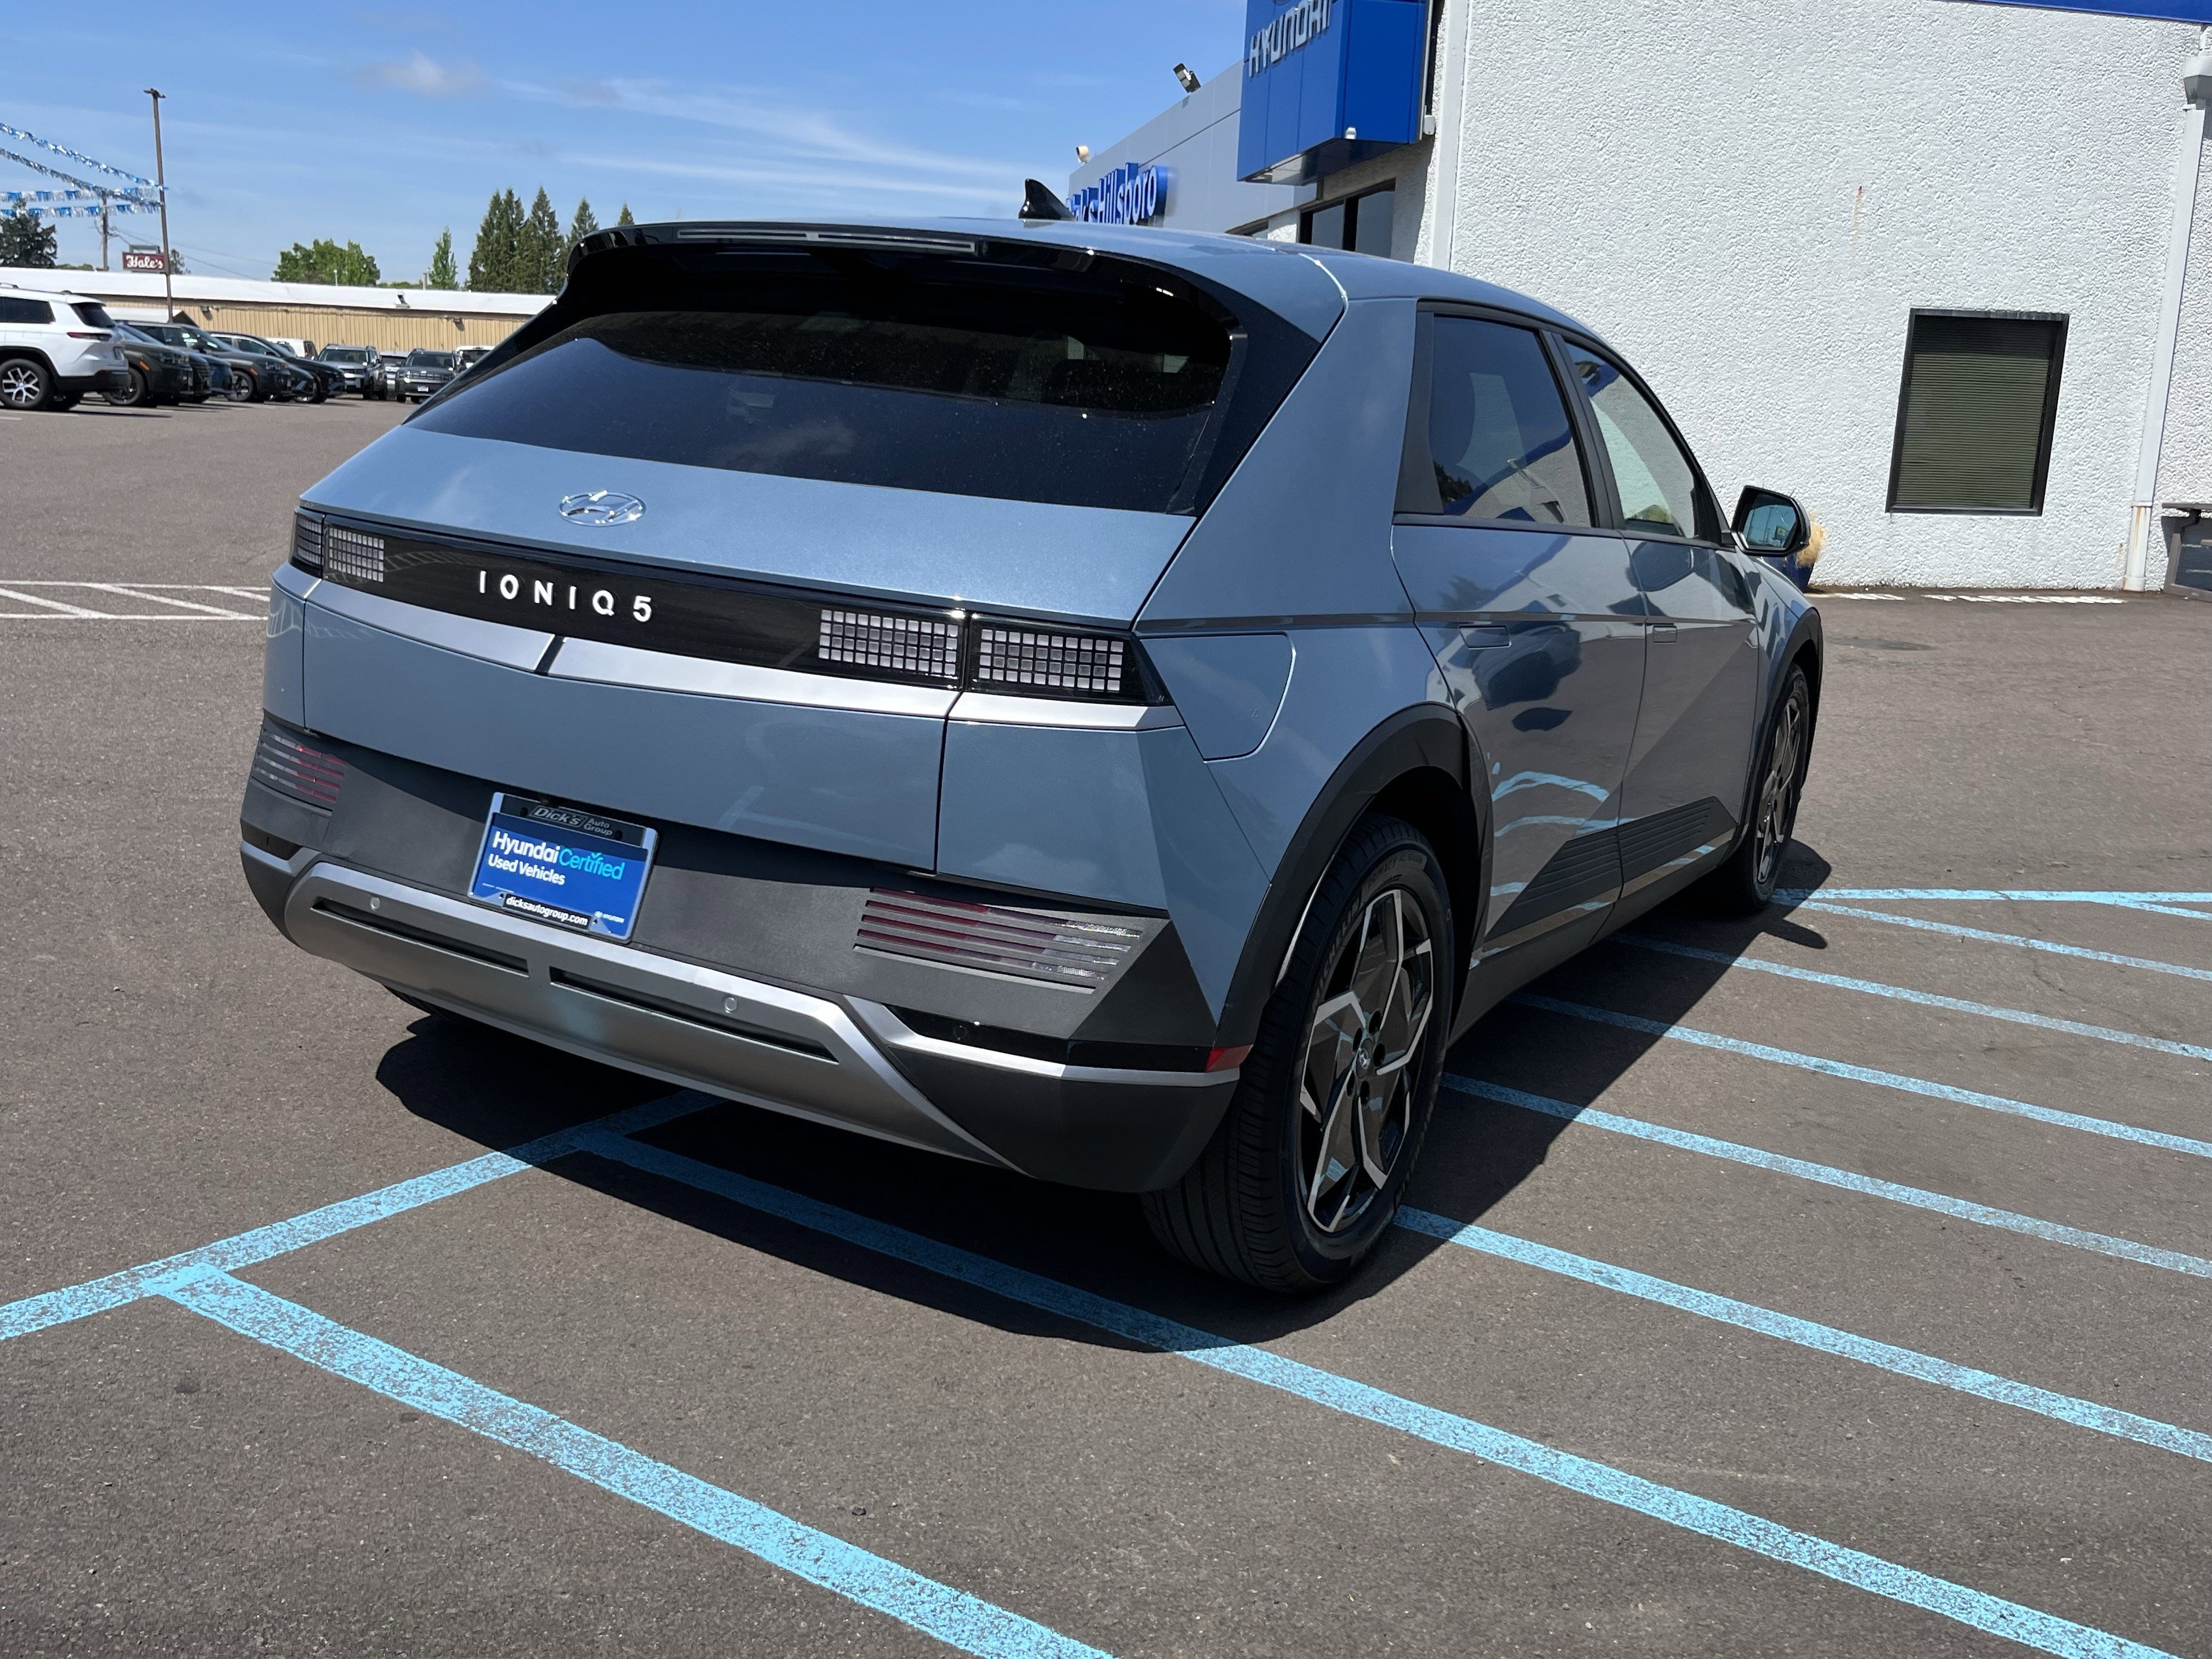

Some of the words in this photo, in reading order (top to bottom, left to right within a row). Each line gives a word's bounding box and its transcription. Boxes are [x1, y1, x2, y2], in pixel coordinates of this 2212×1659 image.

[1249, 0, 1331, 77] HYUNDAI
[1097, 163, 1158, 226] Hillsboro
[126, 255, 163, 269] Hale's
[479, 571, 614, 616] IONIQ
[633, 595, 652, 623] 5
[534, 808, 582, 825] Dick's
[589, 818, 610, 828] Auto
[584, 823, 613, 836] Group
[488, 853, 518, 873] Used
[519, 861, 566, 885] Vehicles
[506, 896, 588, 926] dicksautogroup.com
